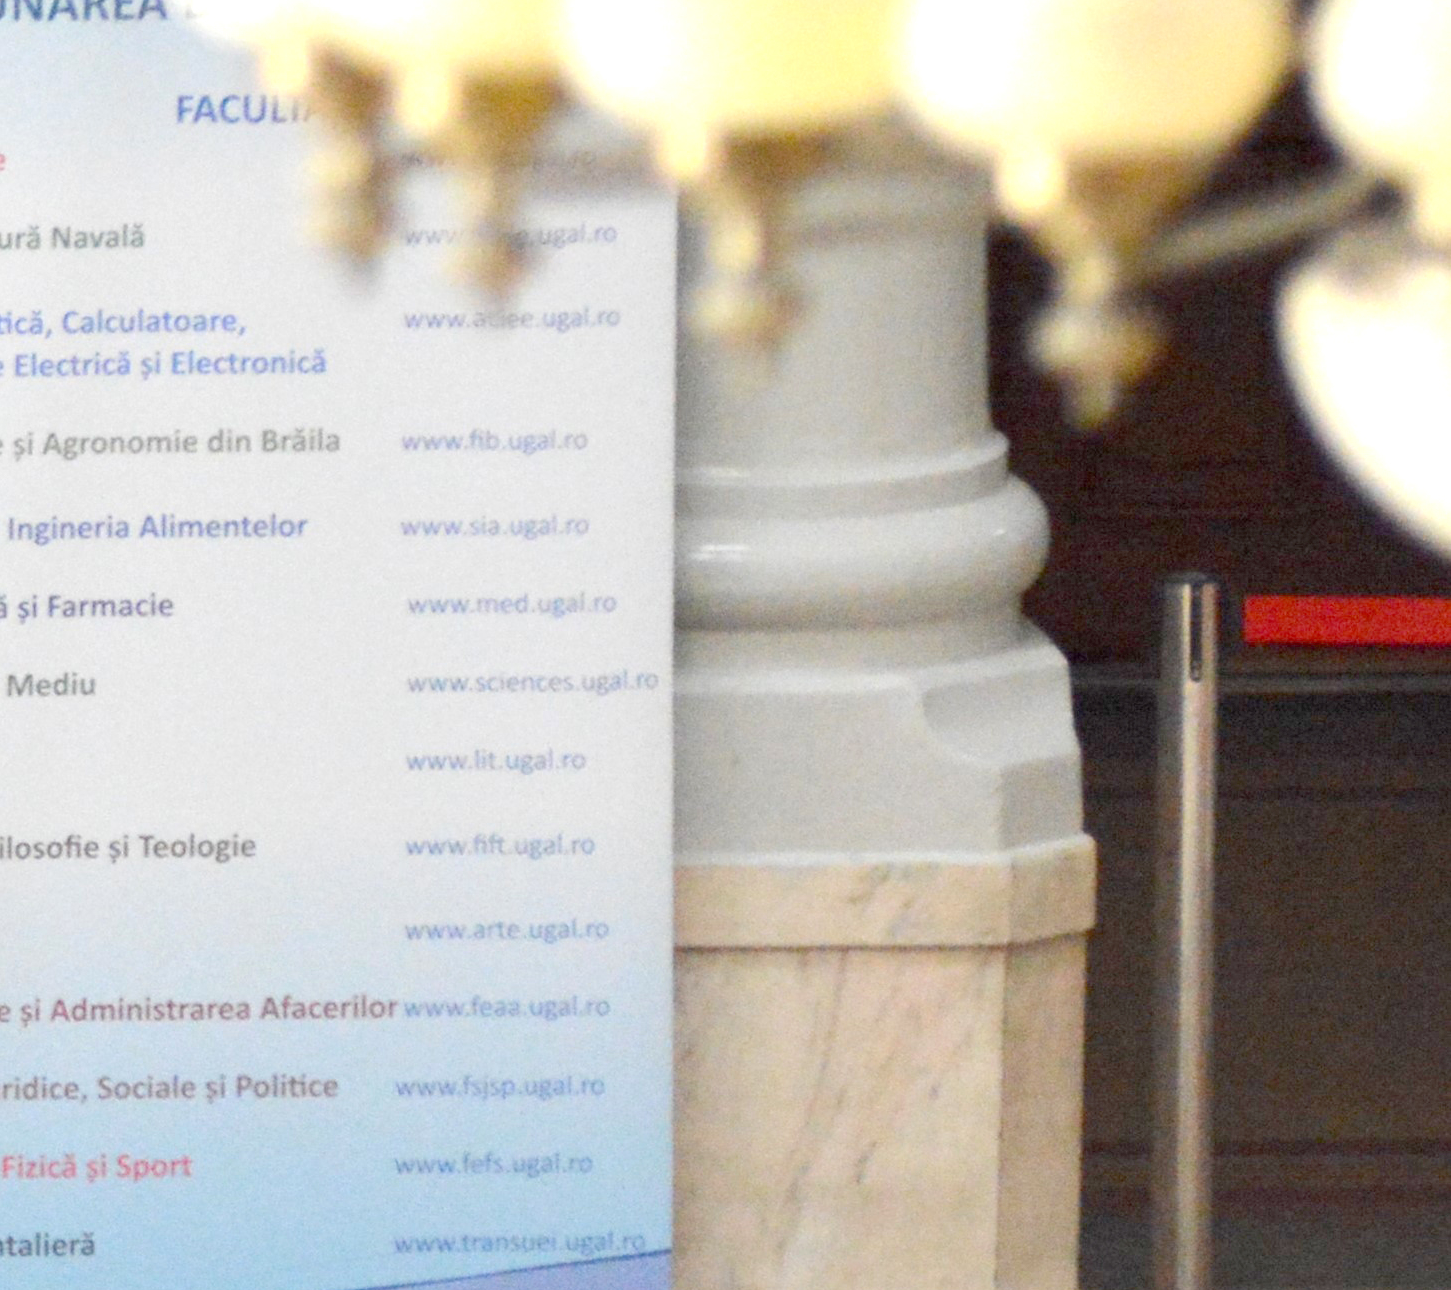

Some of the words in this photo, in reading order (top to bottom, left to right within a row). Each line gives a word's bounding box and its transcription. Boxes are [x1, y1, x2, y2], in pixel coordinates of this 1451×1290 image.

[176, 93, 312, 124] FACUL
[50, 223, 145, 250] Navală
[61, 308, 246, 336] Calculatoare,
[14, 353, 131, 378] Electrică
[140, 357, 161, 381] și
[171, 349, 327, 376] Electronică
[12, 432, 34, 462] și
[41, 429, 198, 462] Agronomie
[207, 428, 251, 454] din
[260, 427, 340, 453] Brăila
[7, 515, 130, 546] Ingineria
[139, 513, 308, 539] Alimentelor
[17, 595, 38, 624] și
[47, 593, 174, 618] Farmacie
[6, 672, 96, 697] Mediu
[108, 834, 129, 864] și
[138, 833, 256, 864] Teologie
[20, 998, 41, 1028] și
[50, 997, 251, 1023] Administrarea
[259, 994, 398, 1020] Afacerilor
[97, 1074, 196, 1101] Sociale
[205, 1074, 226, 1104] și
[235, 1073, 339, 1099] Politice
[0, 1154, 77, 1180] Fizică
[86, 1154, 108, 1184] și
[116, 1154, 192, 1182] Sport
